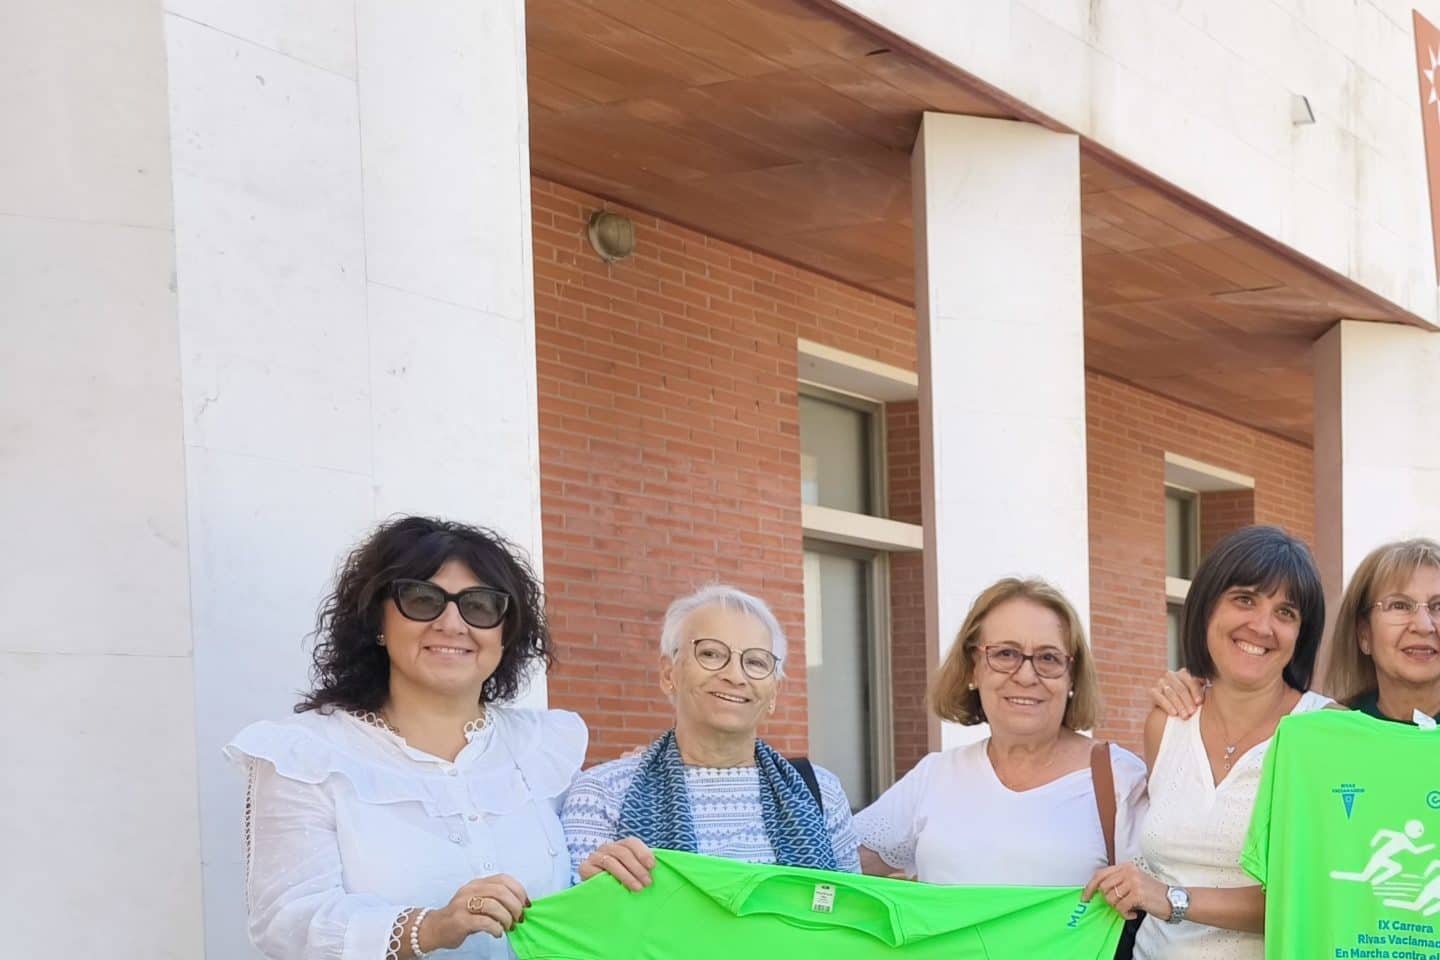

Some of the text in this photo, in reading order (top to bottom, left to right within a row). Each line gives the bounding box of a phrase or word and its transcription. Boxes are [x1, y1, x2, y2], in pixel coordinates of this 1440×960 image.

[1378, 920, 1433, 933] IX Carrera
[1358, 934, 1386, 945] Rivas
[1335, 948, 1349, 958] En
[1351, 948, 1389, 959] Marcha
